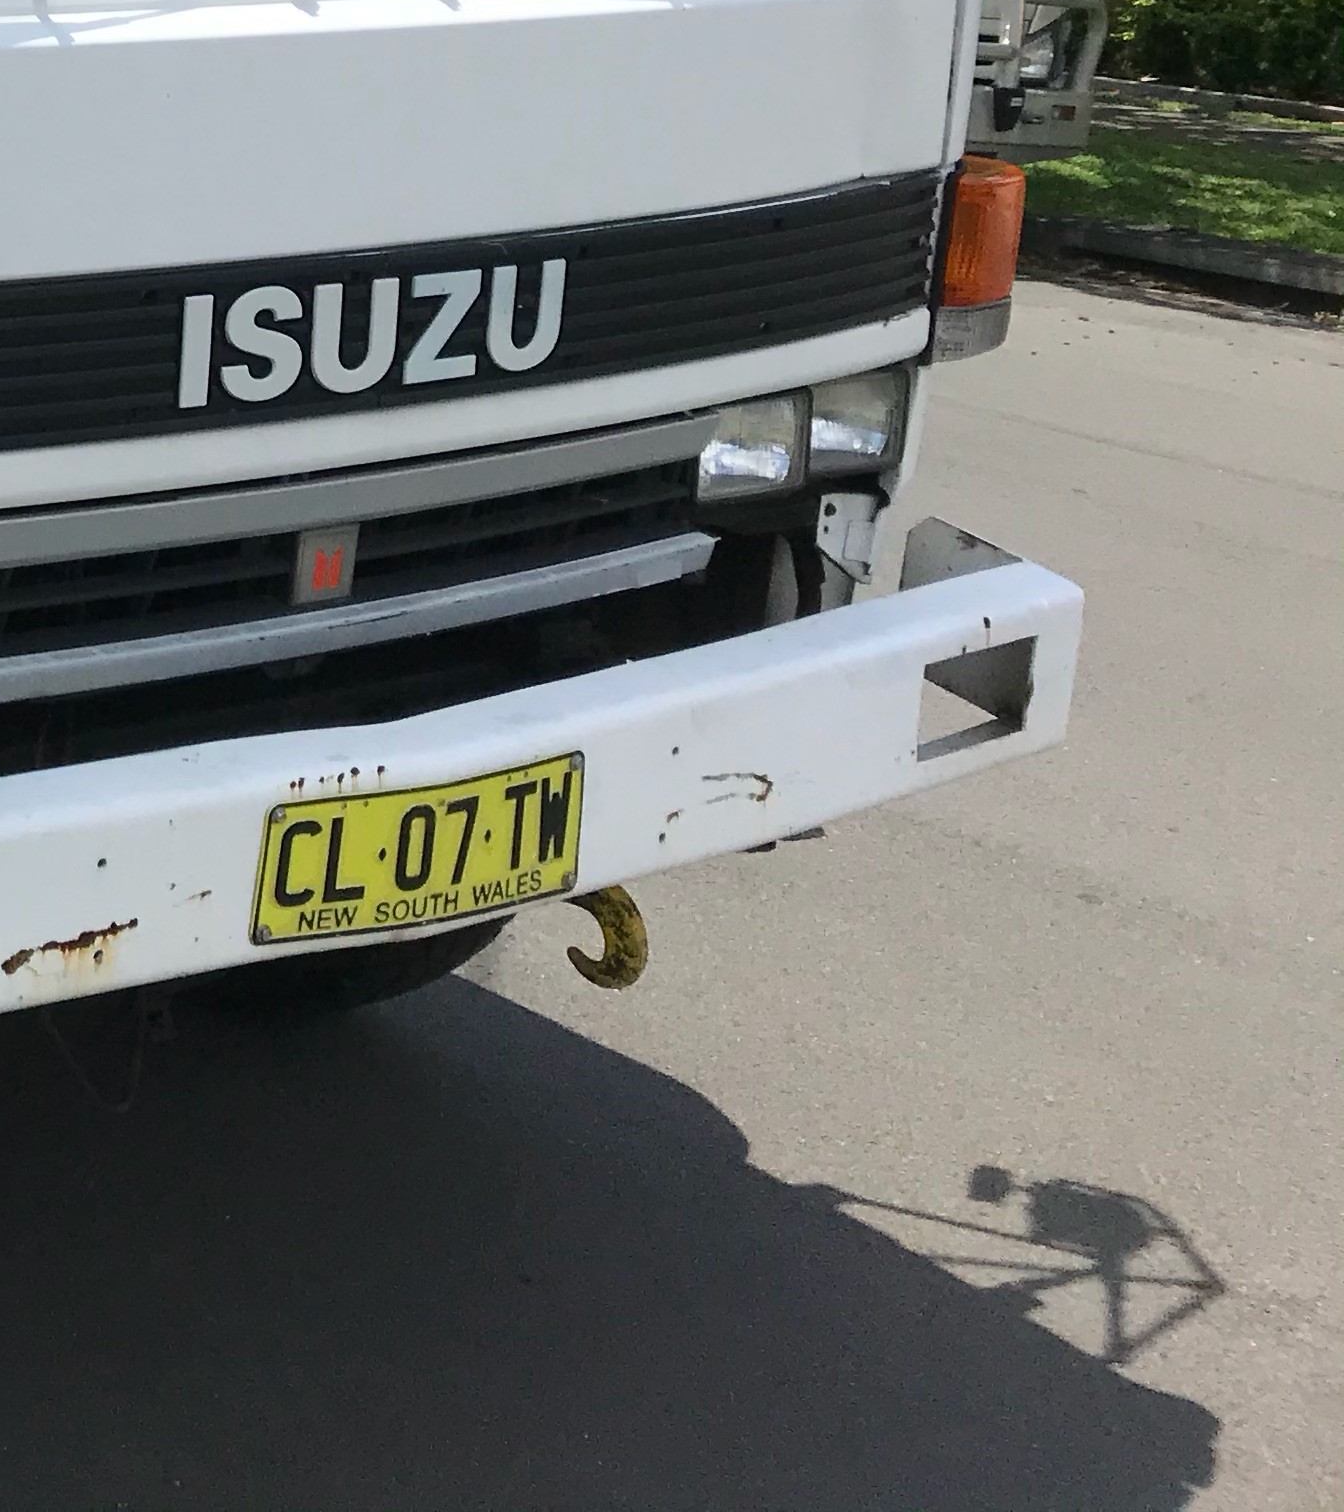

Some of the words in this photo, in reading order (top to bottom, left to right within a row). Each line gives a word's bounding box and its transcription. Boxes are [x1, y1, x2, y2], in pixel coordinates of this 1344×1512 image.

[178, 258, 566, 408] ISUZU
[298, 906, 358, 932] NEW
[375, 891, 459, 923] SOUTH
[472, 869, 542, 905] WALES
